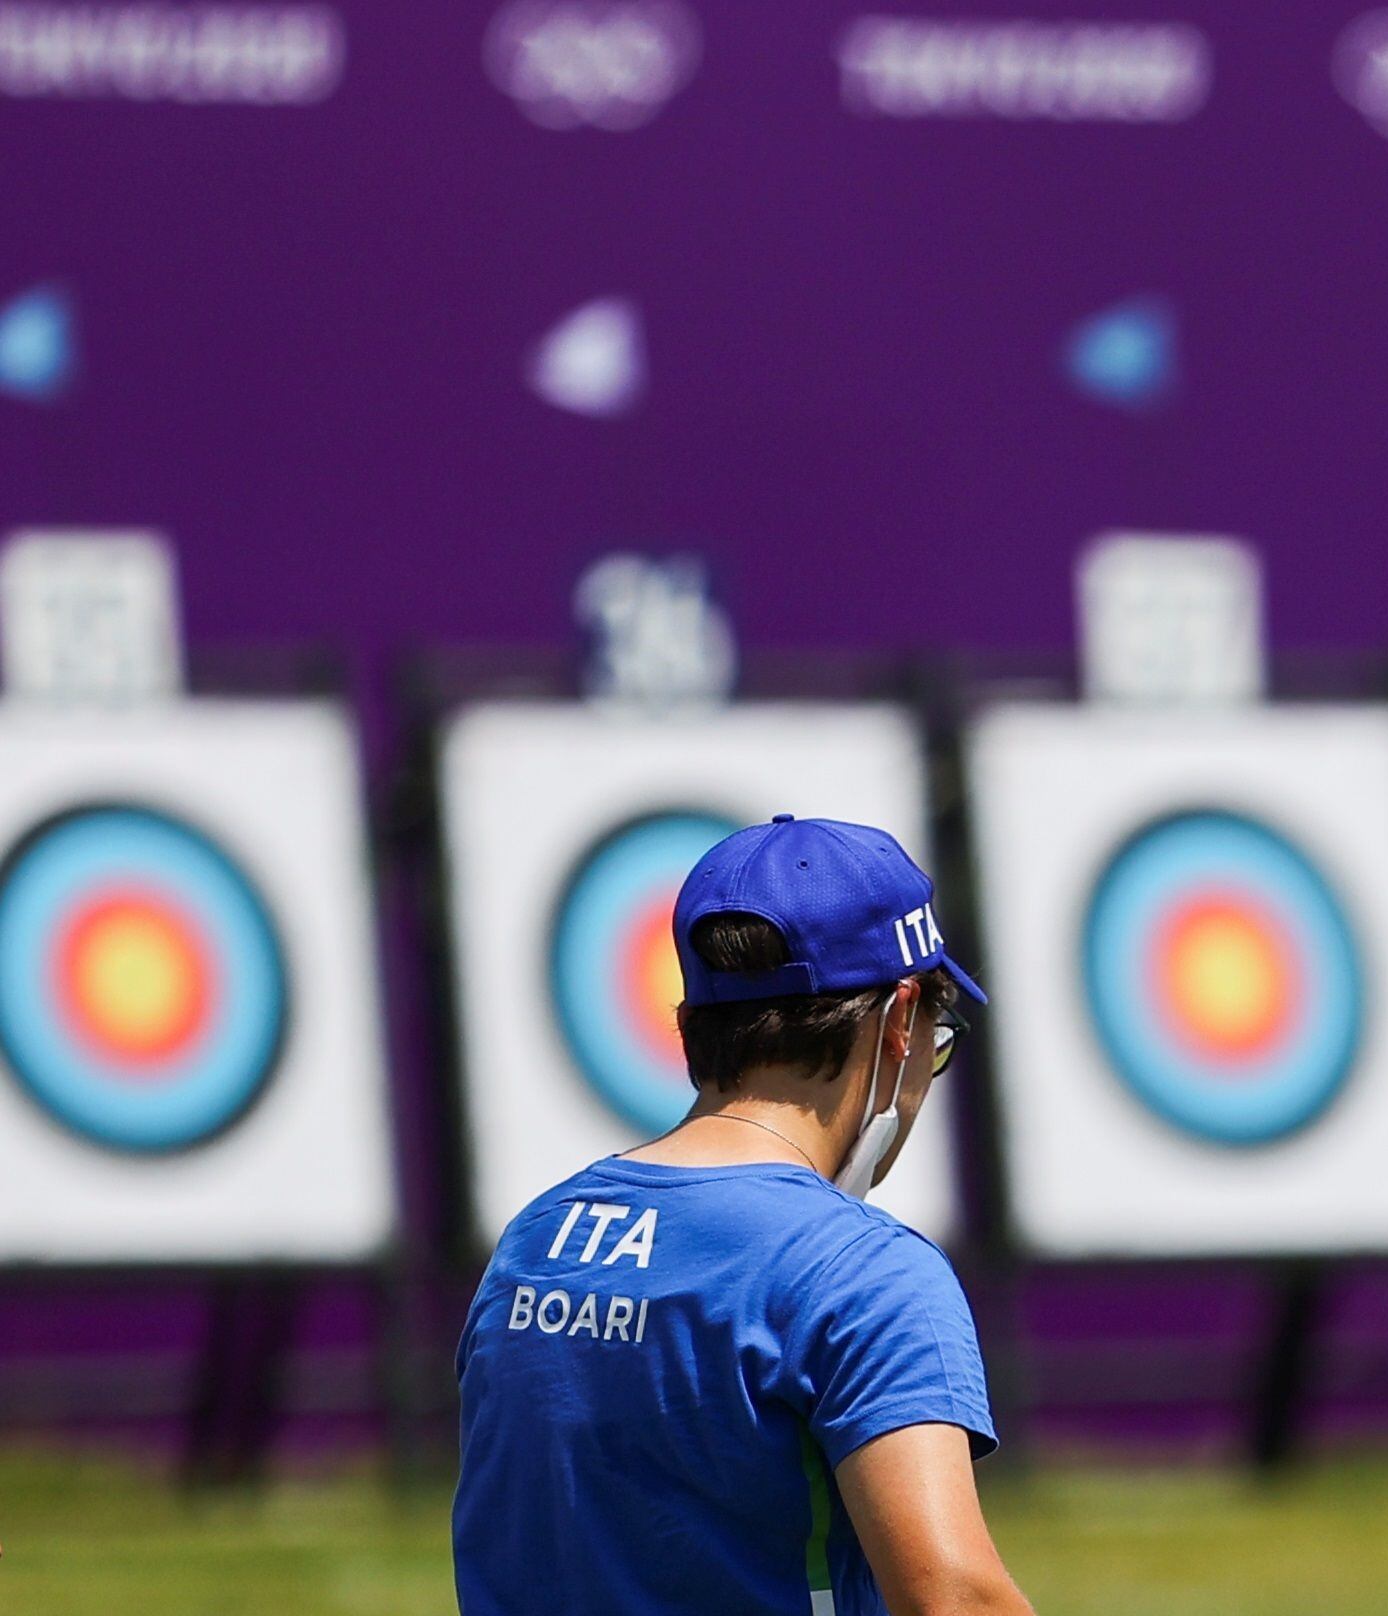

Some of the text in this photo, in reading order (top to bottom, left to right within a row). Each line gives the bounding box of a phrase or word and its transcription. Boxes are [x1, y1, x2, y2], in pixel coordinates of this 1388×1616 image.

[895, 902, 944, 967] ITA
[547, 1201, 658, 1269] ITA
[508, 1285, 650, 1343] BOARI
